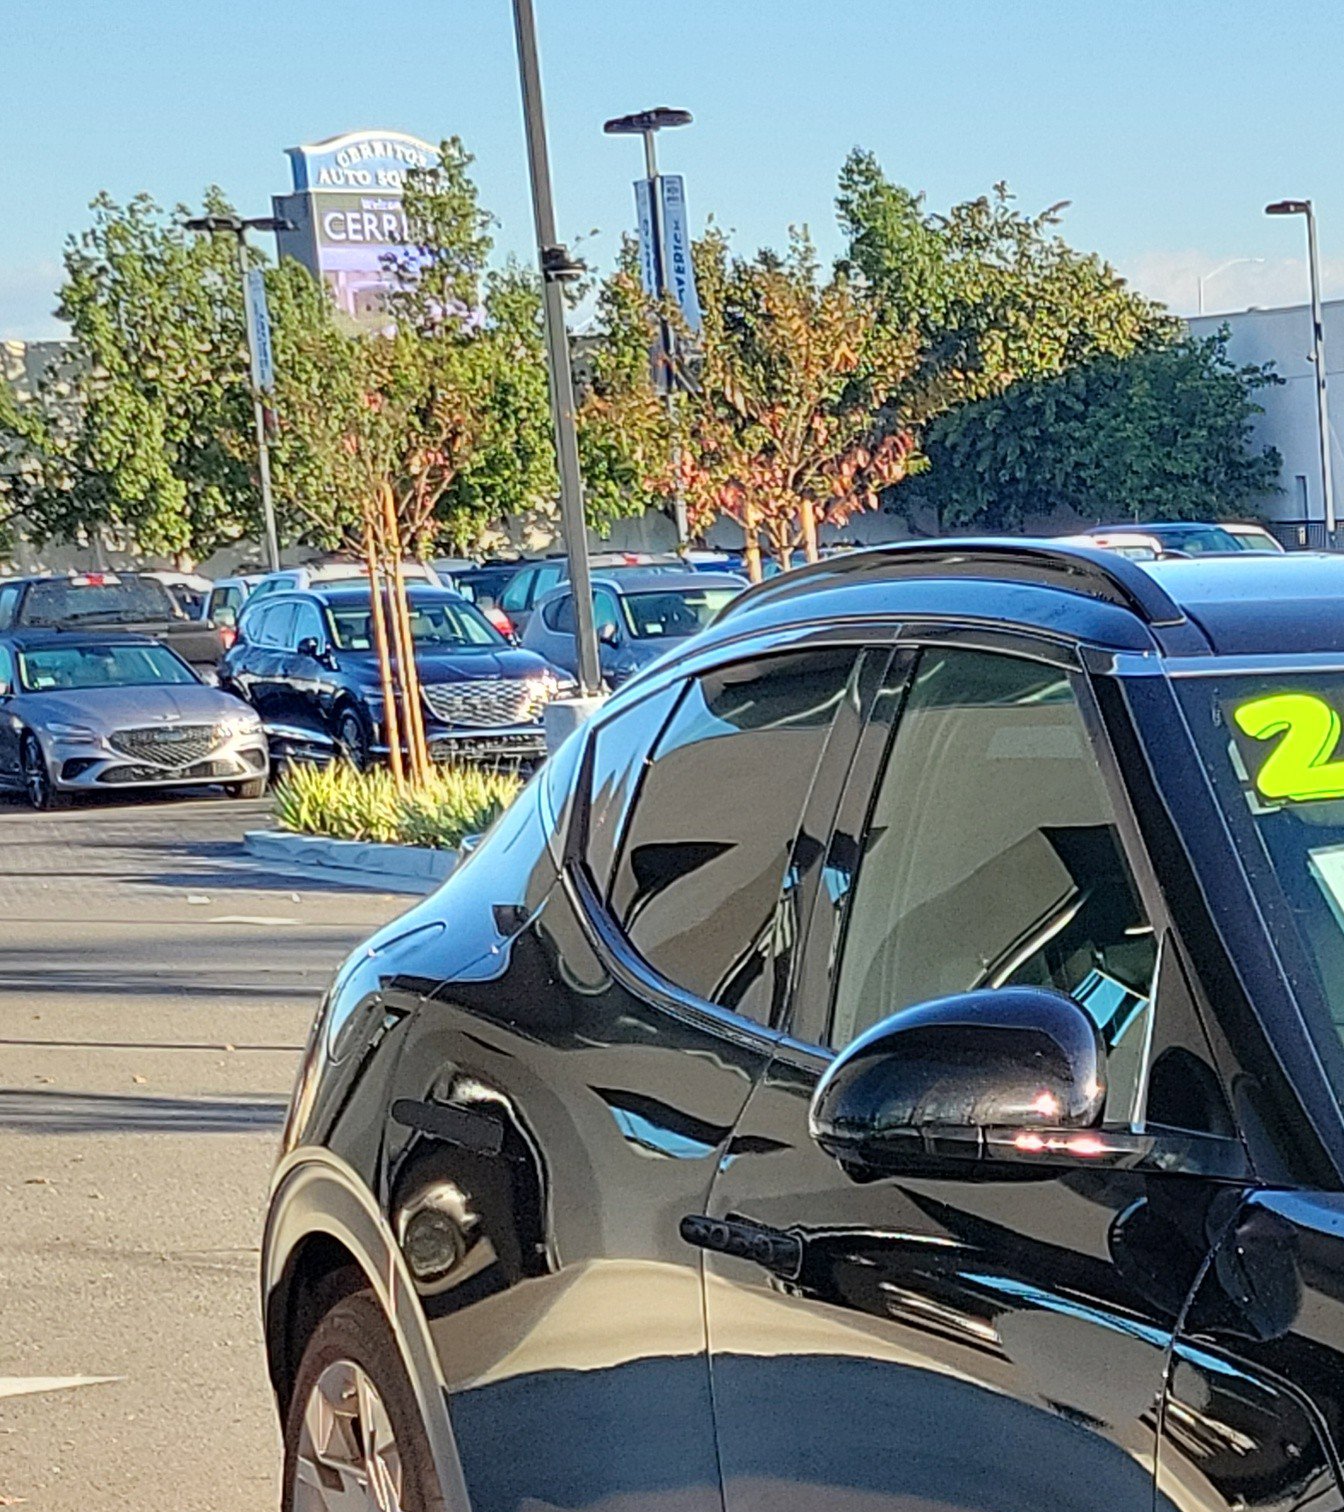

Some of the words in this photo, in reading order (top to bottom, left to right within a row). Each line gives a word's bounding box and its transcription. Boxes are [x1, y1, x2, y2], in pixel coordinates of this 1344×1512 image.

[337, 141, 428, 169] CERRITOS
[319, 168, 372, 186] AUTO
[323, 211, 412, 242] CERRI
